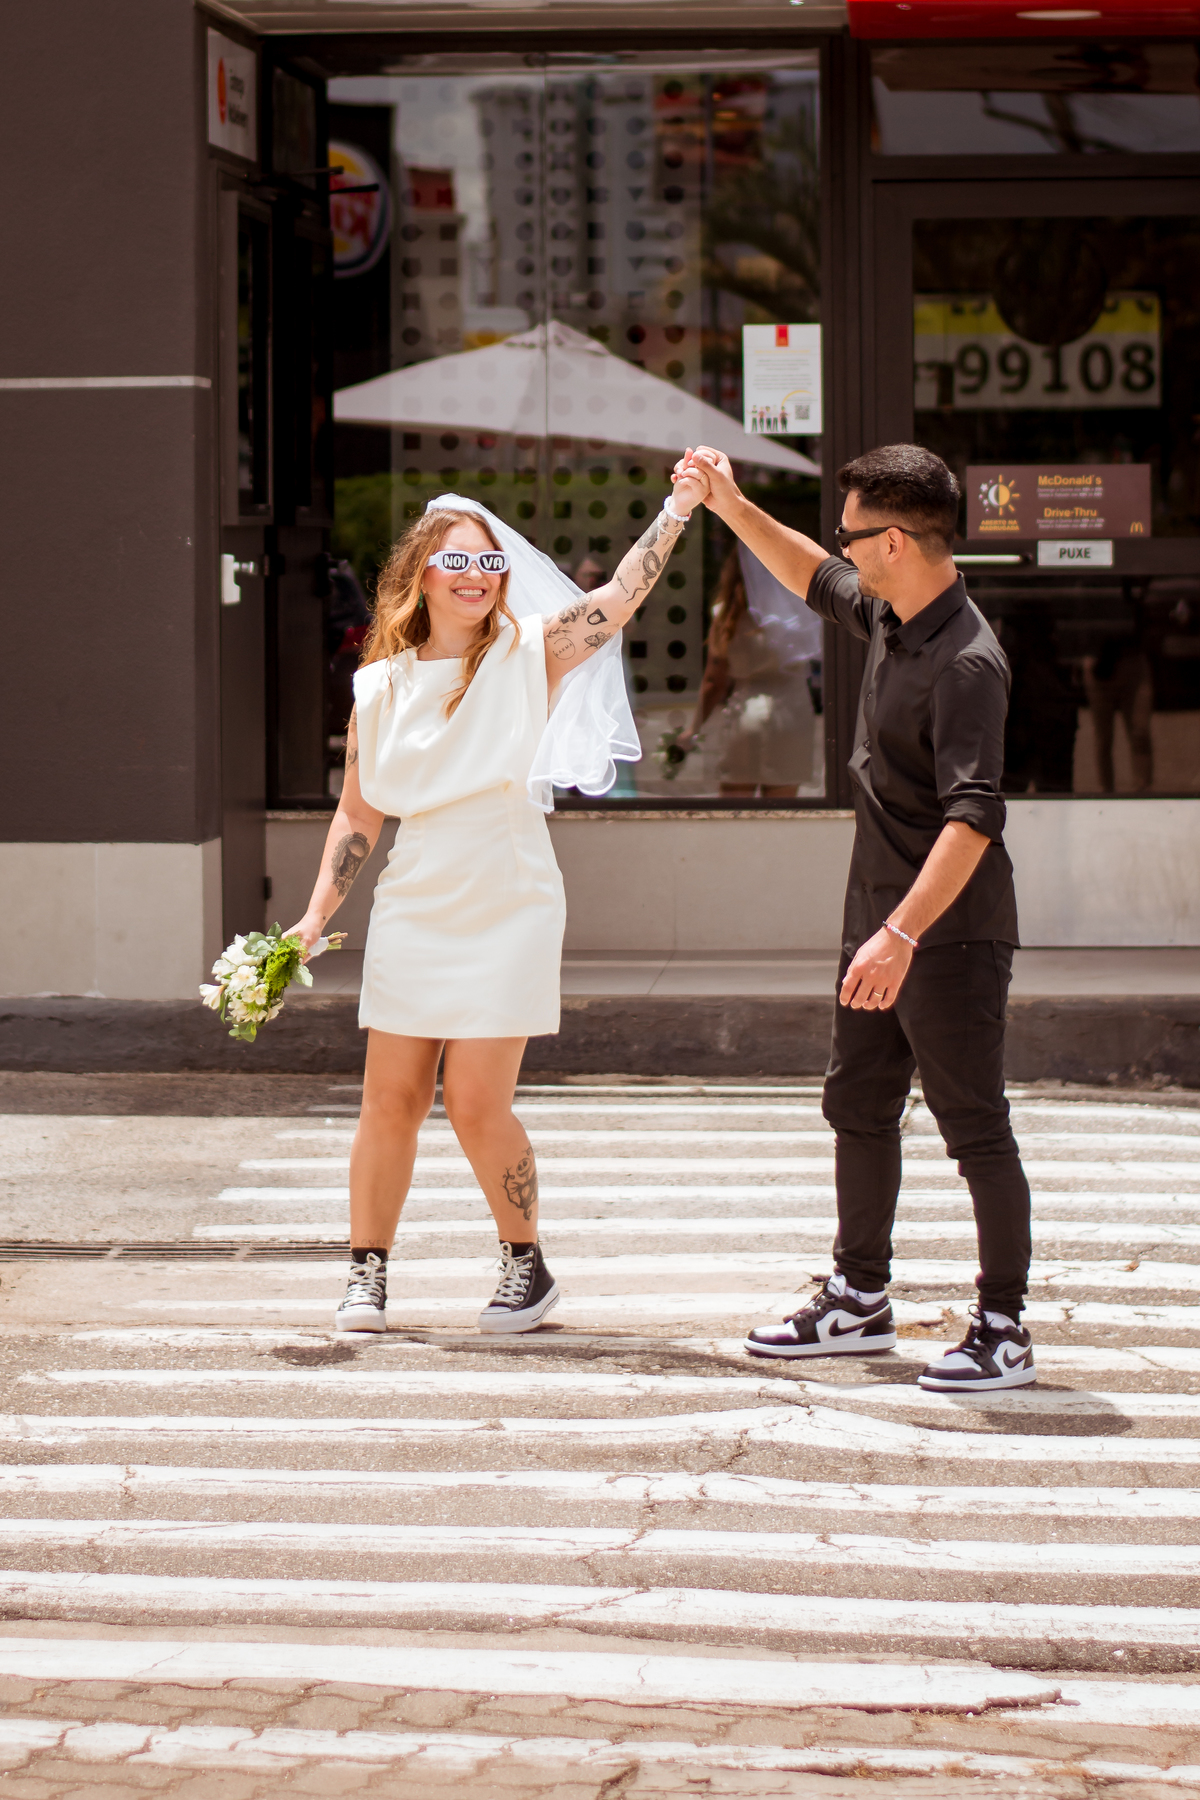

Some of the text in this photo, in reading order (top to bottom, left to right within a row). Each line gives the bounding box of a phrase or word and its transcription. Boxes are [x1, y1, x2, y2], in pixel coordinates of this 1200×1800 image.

[1044, 507, 1097, 517] Drive-Thru
[1059, 547, 1091, 559] PUXE
[444, 554, 504, 569] NOI VA
